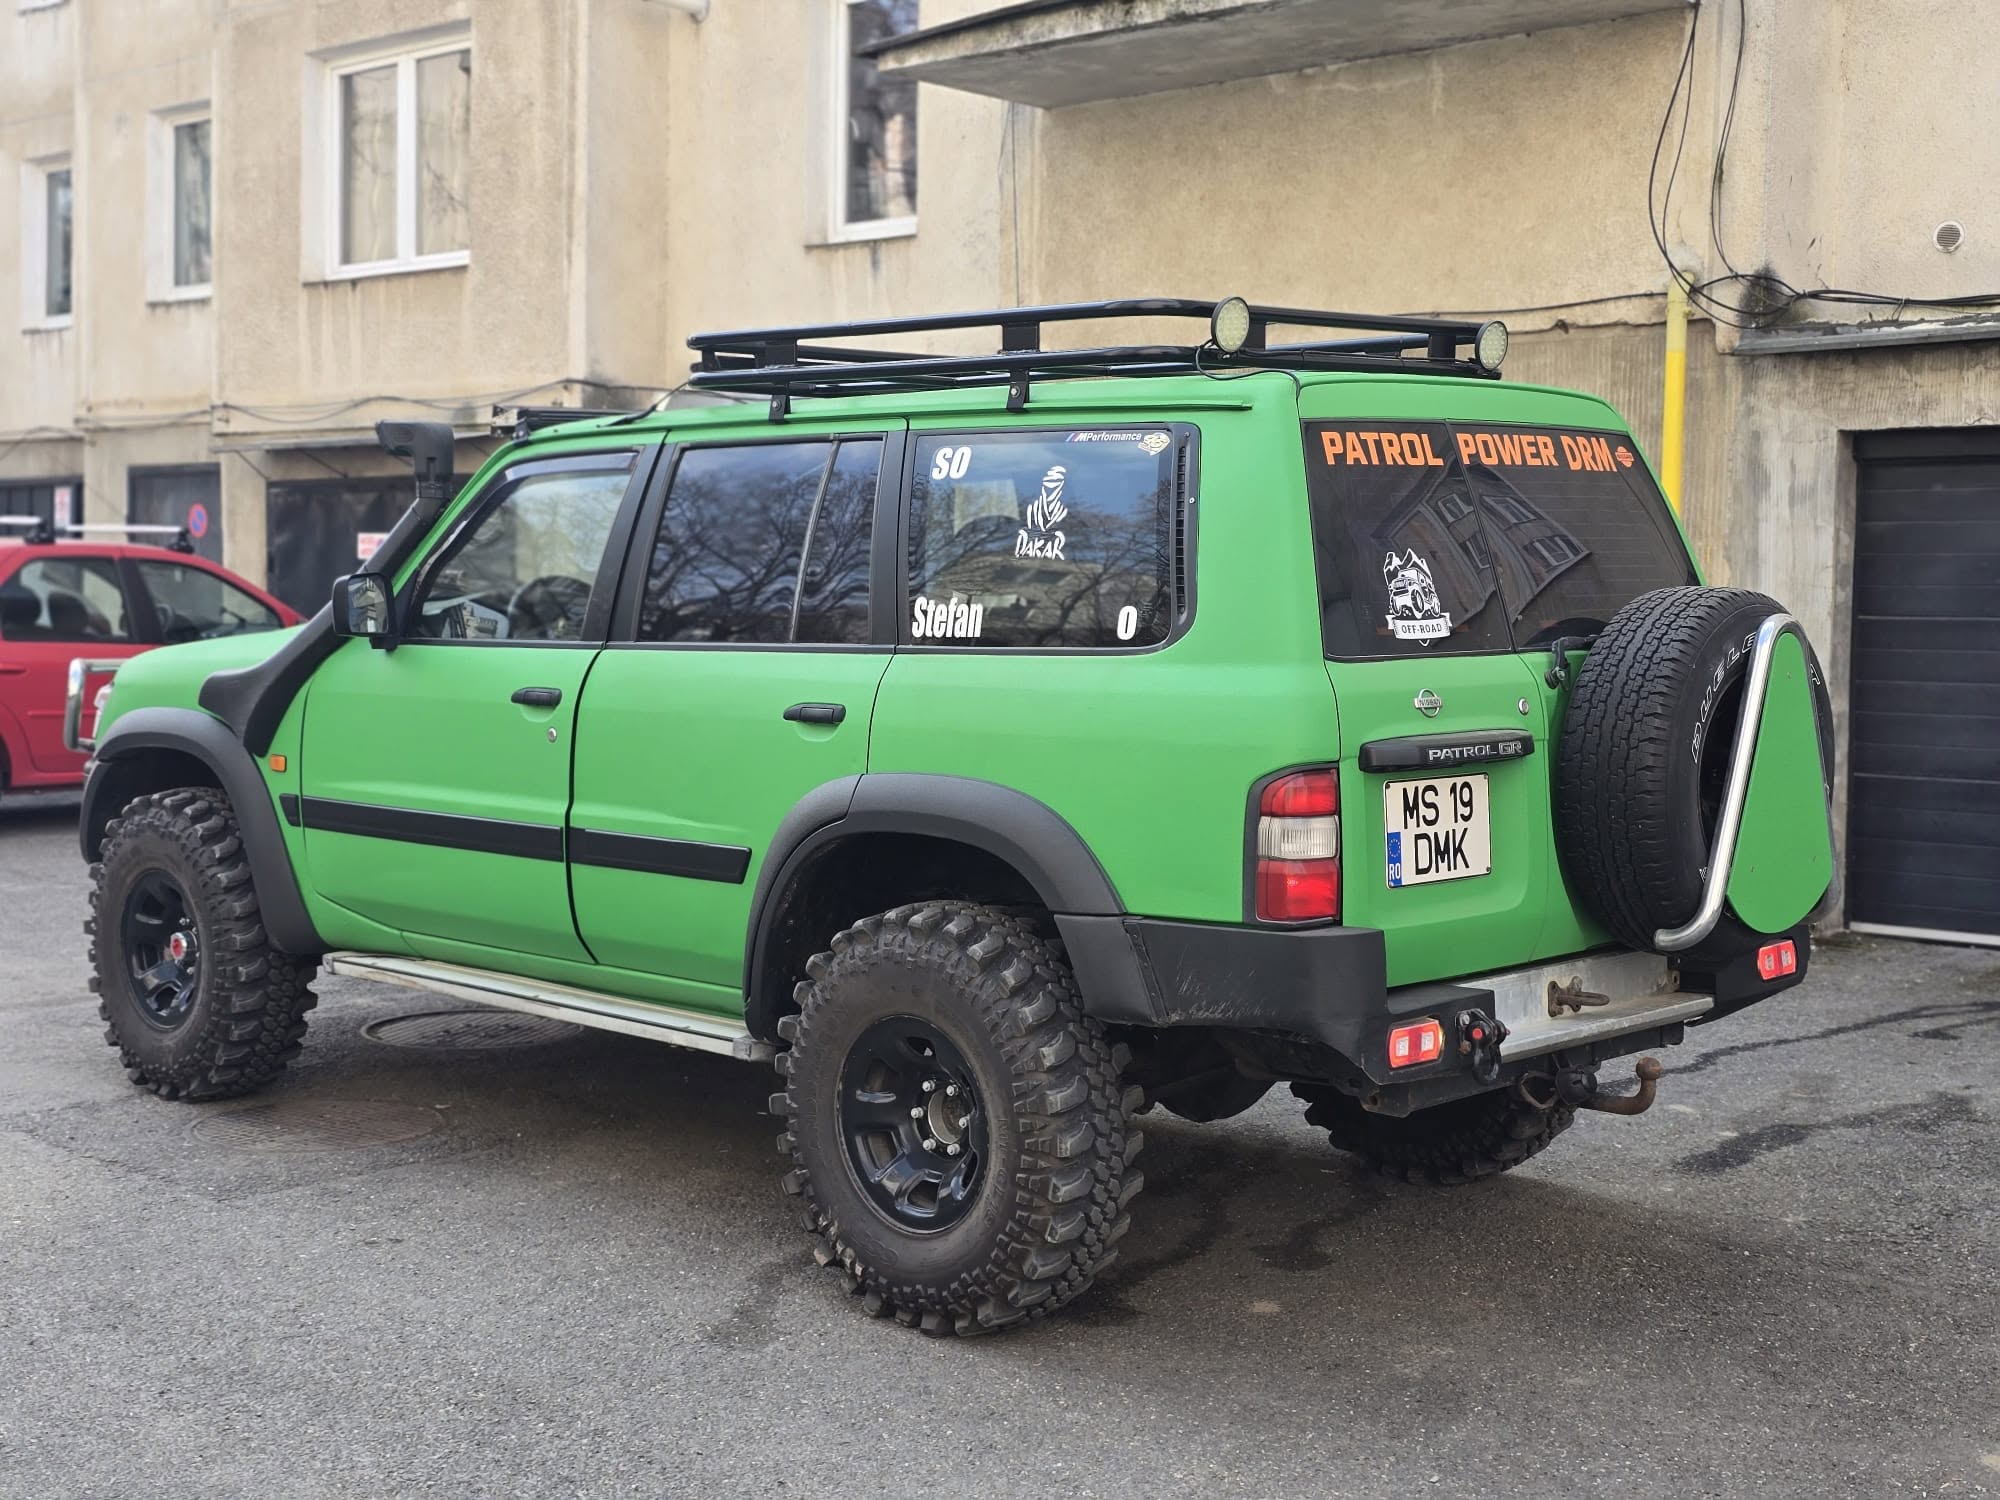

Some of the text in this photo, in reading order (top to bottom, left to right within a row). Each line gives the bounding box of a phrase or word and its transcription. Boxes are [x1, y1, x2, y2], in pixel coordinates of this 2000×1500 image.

[1320, 430, 1618, 473] PATROL POWER DRM
[1014, 529, 1066, 561] DAKAR
[911, 597, 984, 638] Stefan
[1401, 623, 1443, 635] OFF-ROAD
[1428, 741, 1522, 761] PATROL GR
[1402, 781, 1474, 830] MS 19
[1414, 827, 1470, 876] DMK
[1388, 862, 1401, 880] RO
